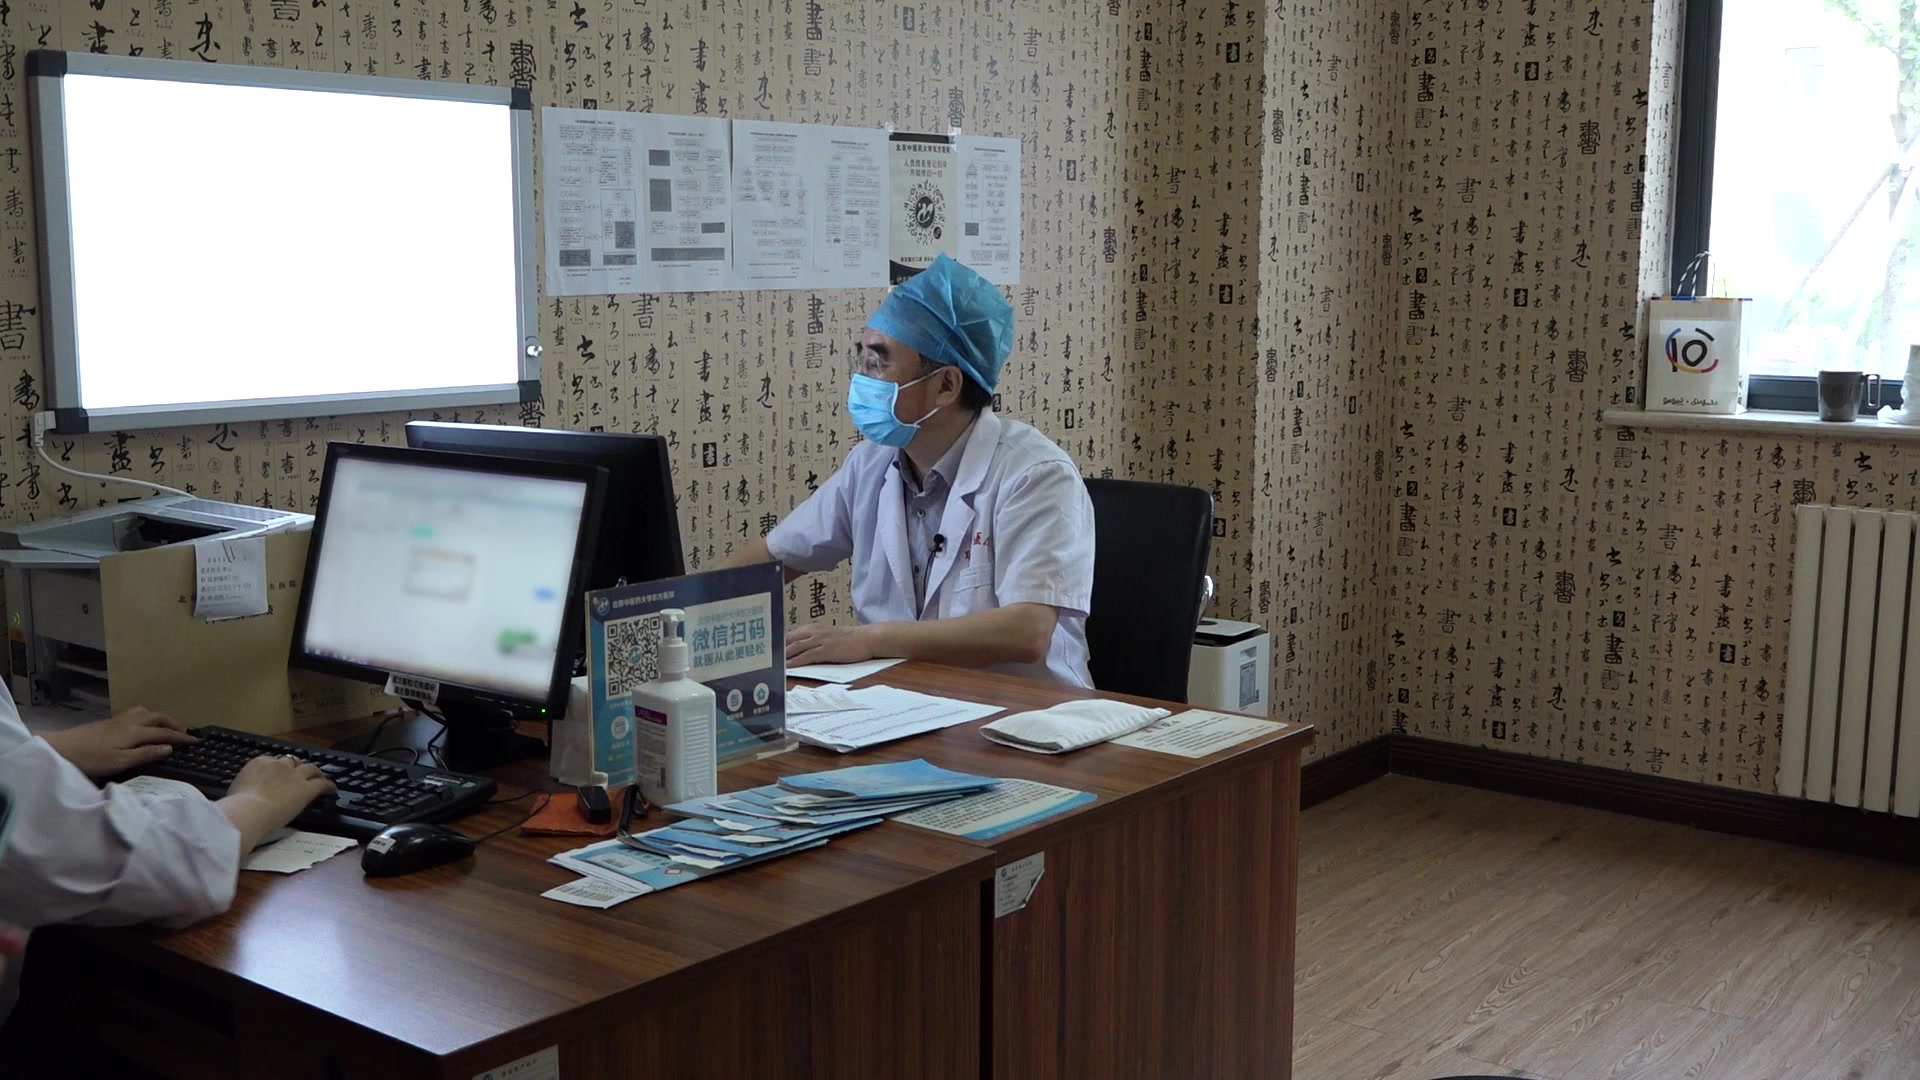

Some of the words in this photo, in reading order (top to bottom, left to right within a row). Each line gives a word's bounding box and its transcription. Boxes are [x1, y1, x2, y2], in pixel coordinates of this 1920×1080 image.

[692, 616, 765, 653] 微信扫码
[693, 642, 766, 668] 就医从此更轻松
